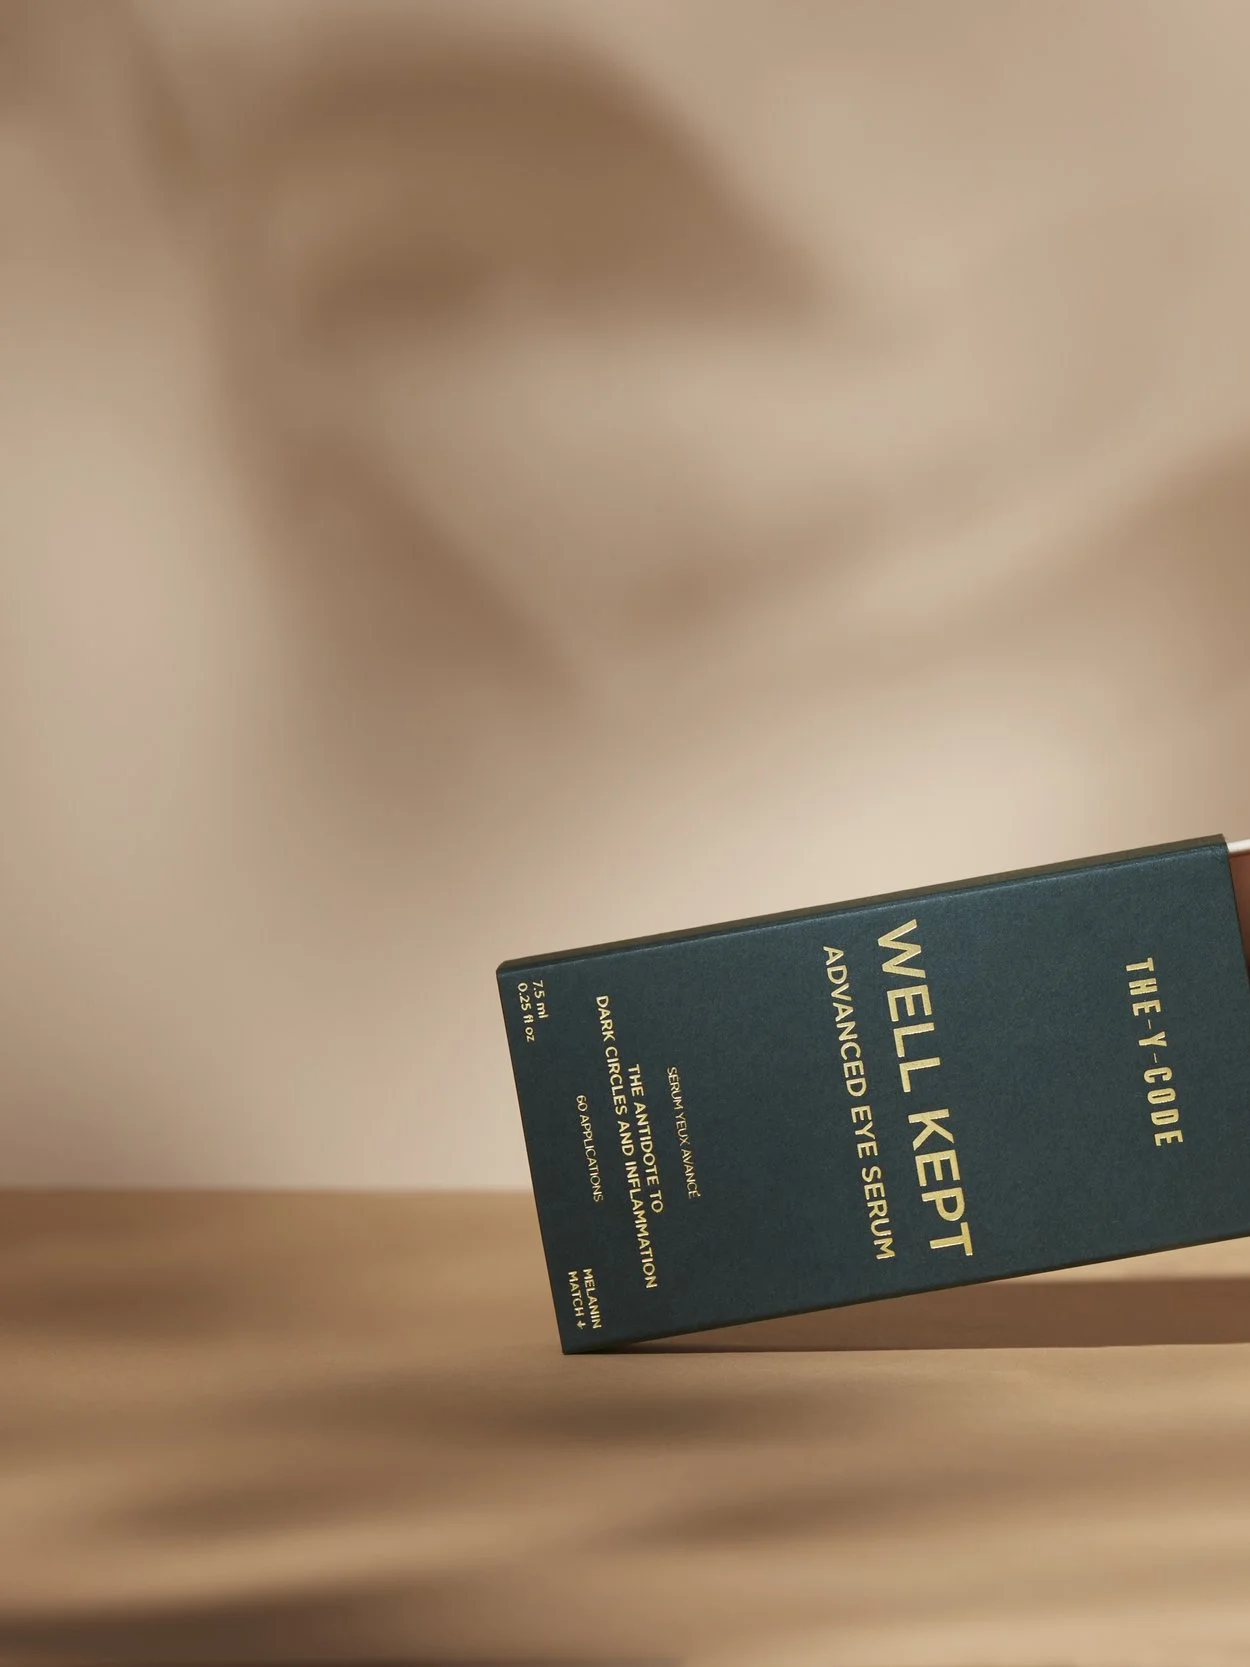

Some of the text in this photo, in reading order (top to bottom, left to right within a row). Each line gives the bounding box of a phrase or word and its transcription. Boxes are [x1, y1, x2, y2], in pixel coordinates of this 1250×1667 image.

[517, 982, 535, 1043] 0.25 fl oz
[532, 979, 549, 1019] 7.5 ml
[1125, 956, 1184, 1148] THE-Y-CODE
[596, 994, 658, 1289] DARK CIRCLES AND INFLAMMATION
[627, 1063, 664, 1214] THE ANTIDOTE TO
[675, 1112, 691, 1147] YEUX
[823, 945, 896, 1261] ADVANCED EYE SERUM
[877, 918, 974, 1258] WELL KEPT
[576, 1094, 604, 1204] 60 APPLICATIONS
[568, 1270, 585, 1317] MATCH
[582, 1268, 603, 1329] MELANIN
